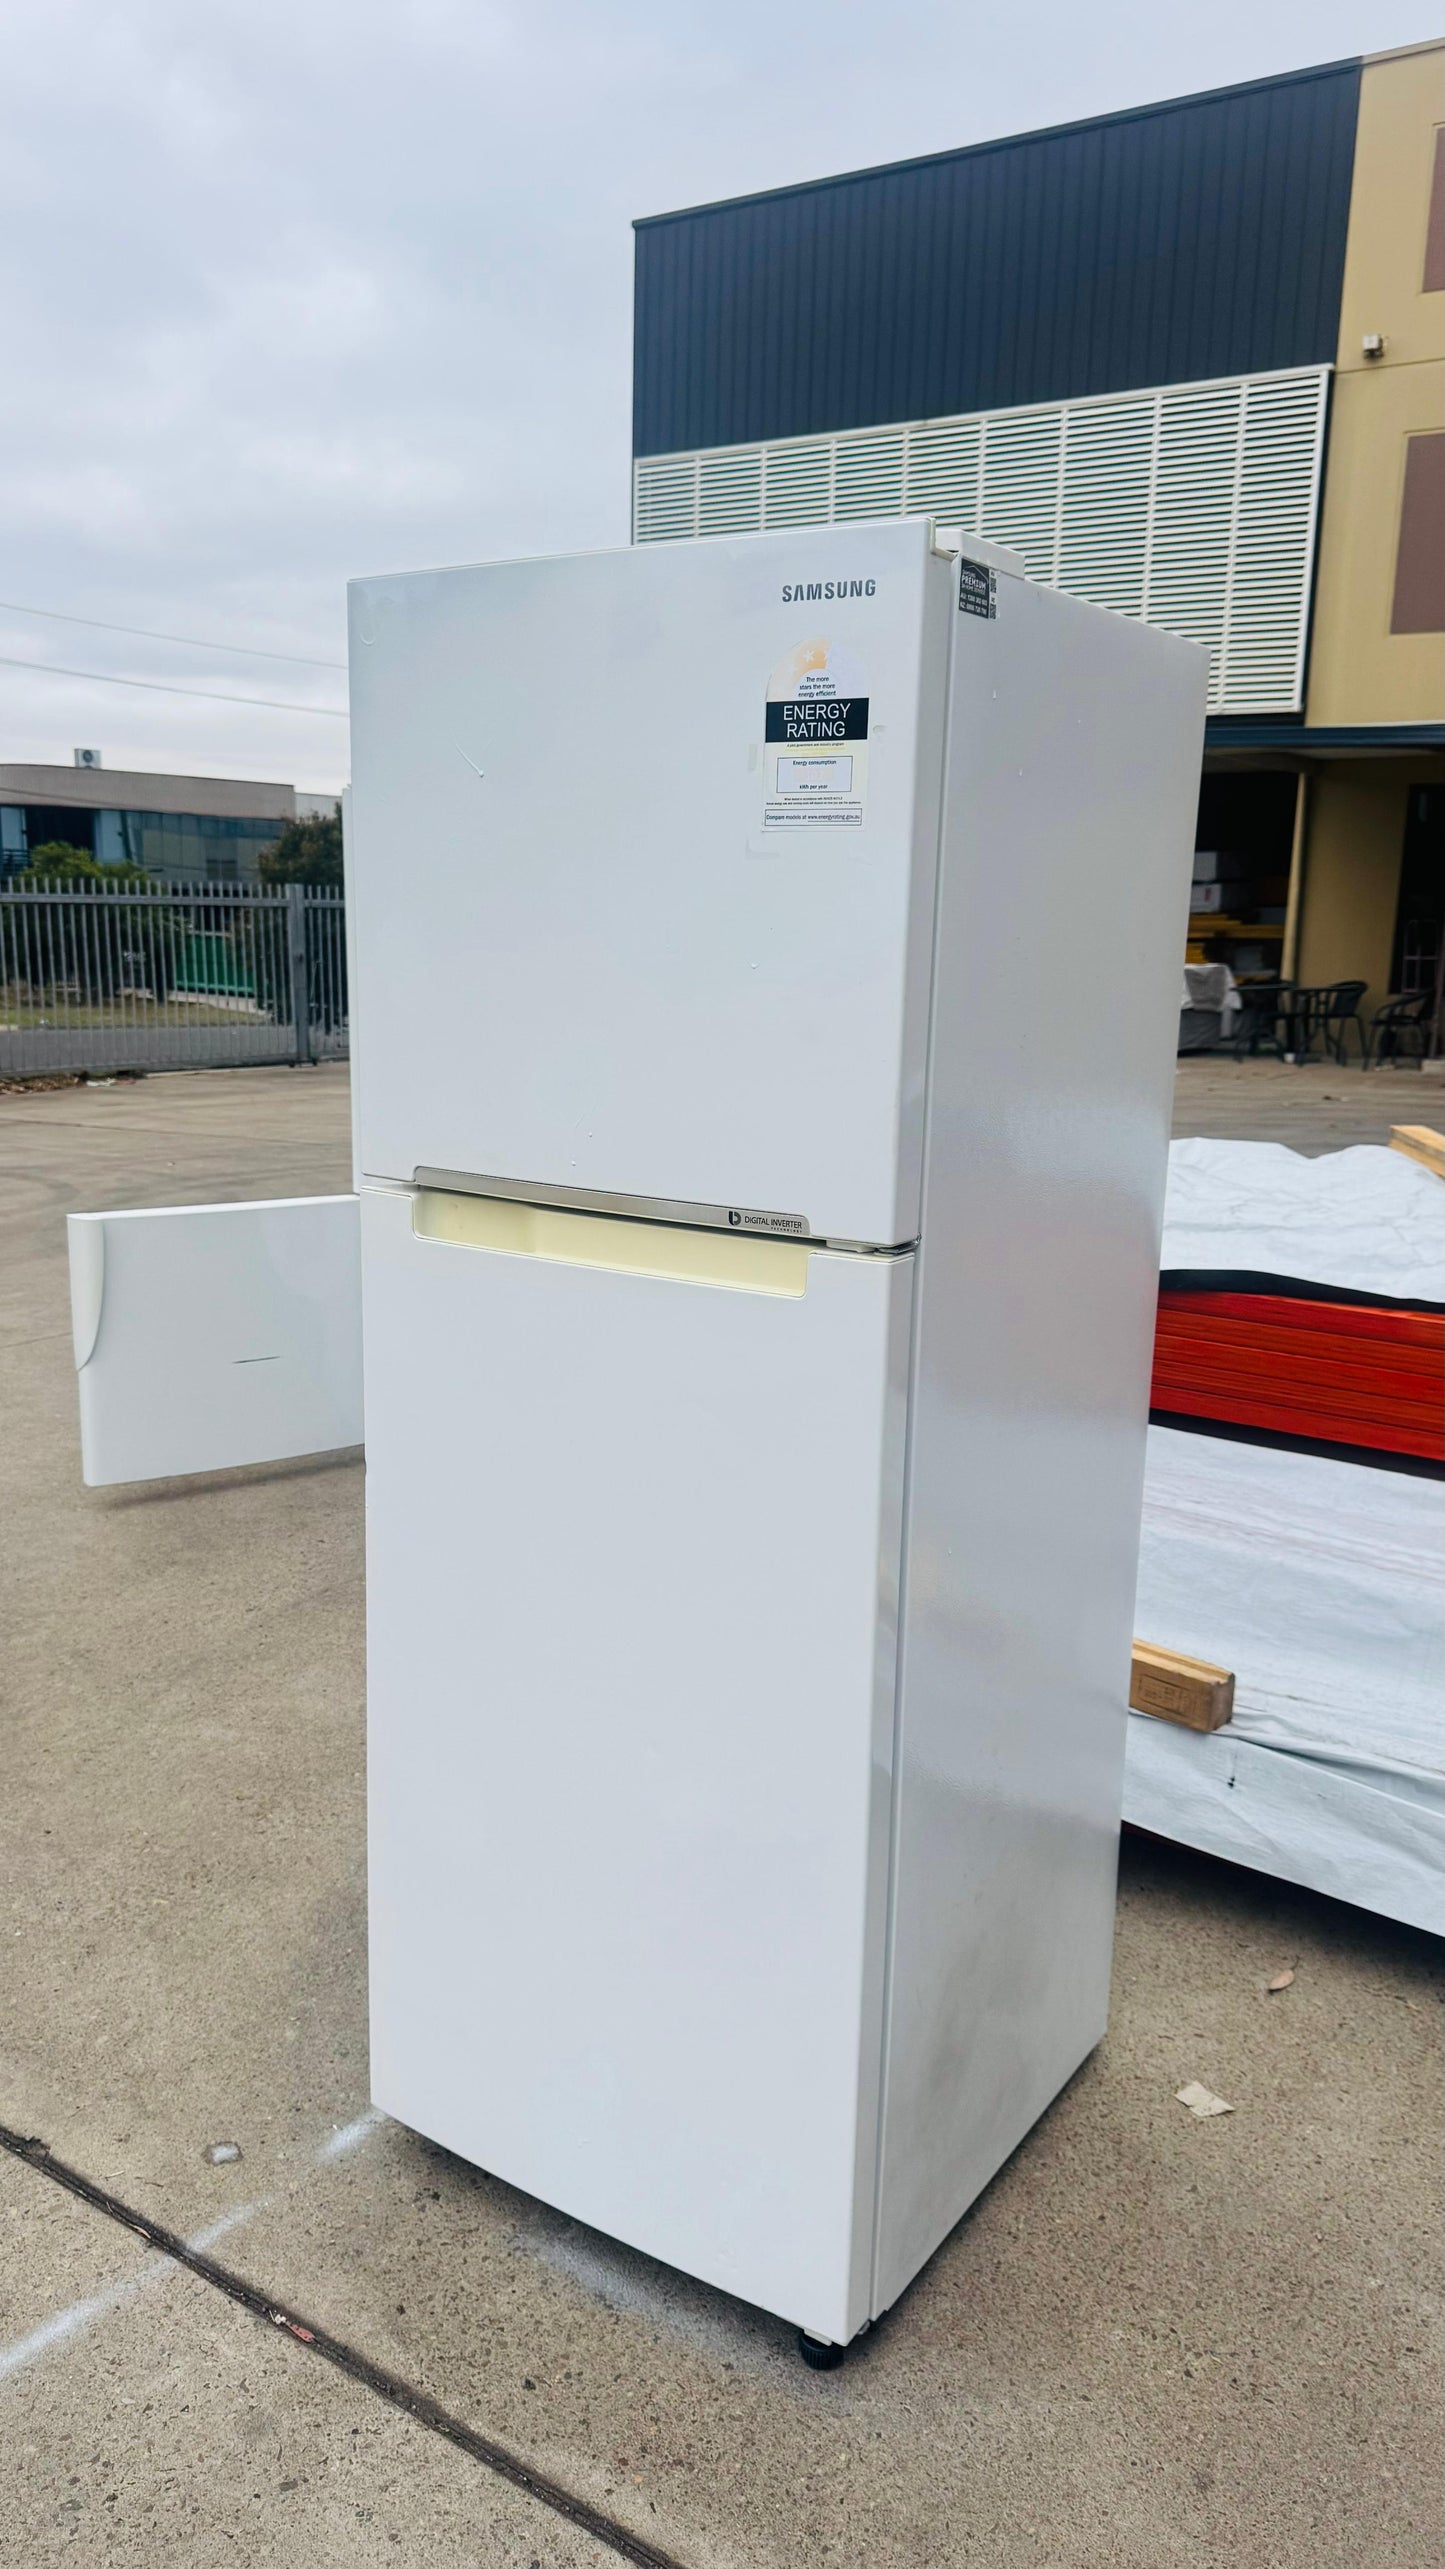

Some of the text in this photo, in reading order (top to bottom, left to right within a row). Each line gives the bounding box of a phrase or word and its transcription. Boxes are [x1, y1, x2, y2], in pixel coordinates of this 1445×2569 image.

[962, 574, 986, 589] PREMIUM
[782, 579, 876, 602] SAMSUNG
[783, 703, 851, 720] ENERGY
[787, 721, 846, 738] RATING
[744, 1215, 802, 1229] DIGITAL INVERTER
